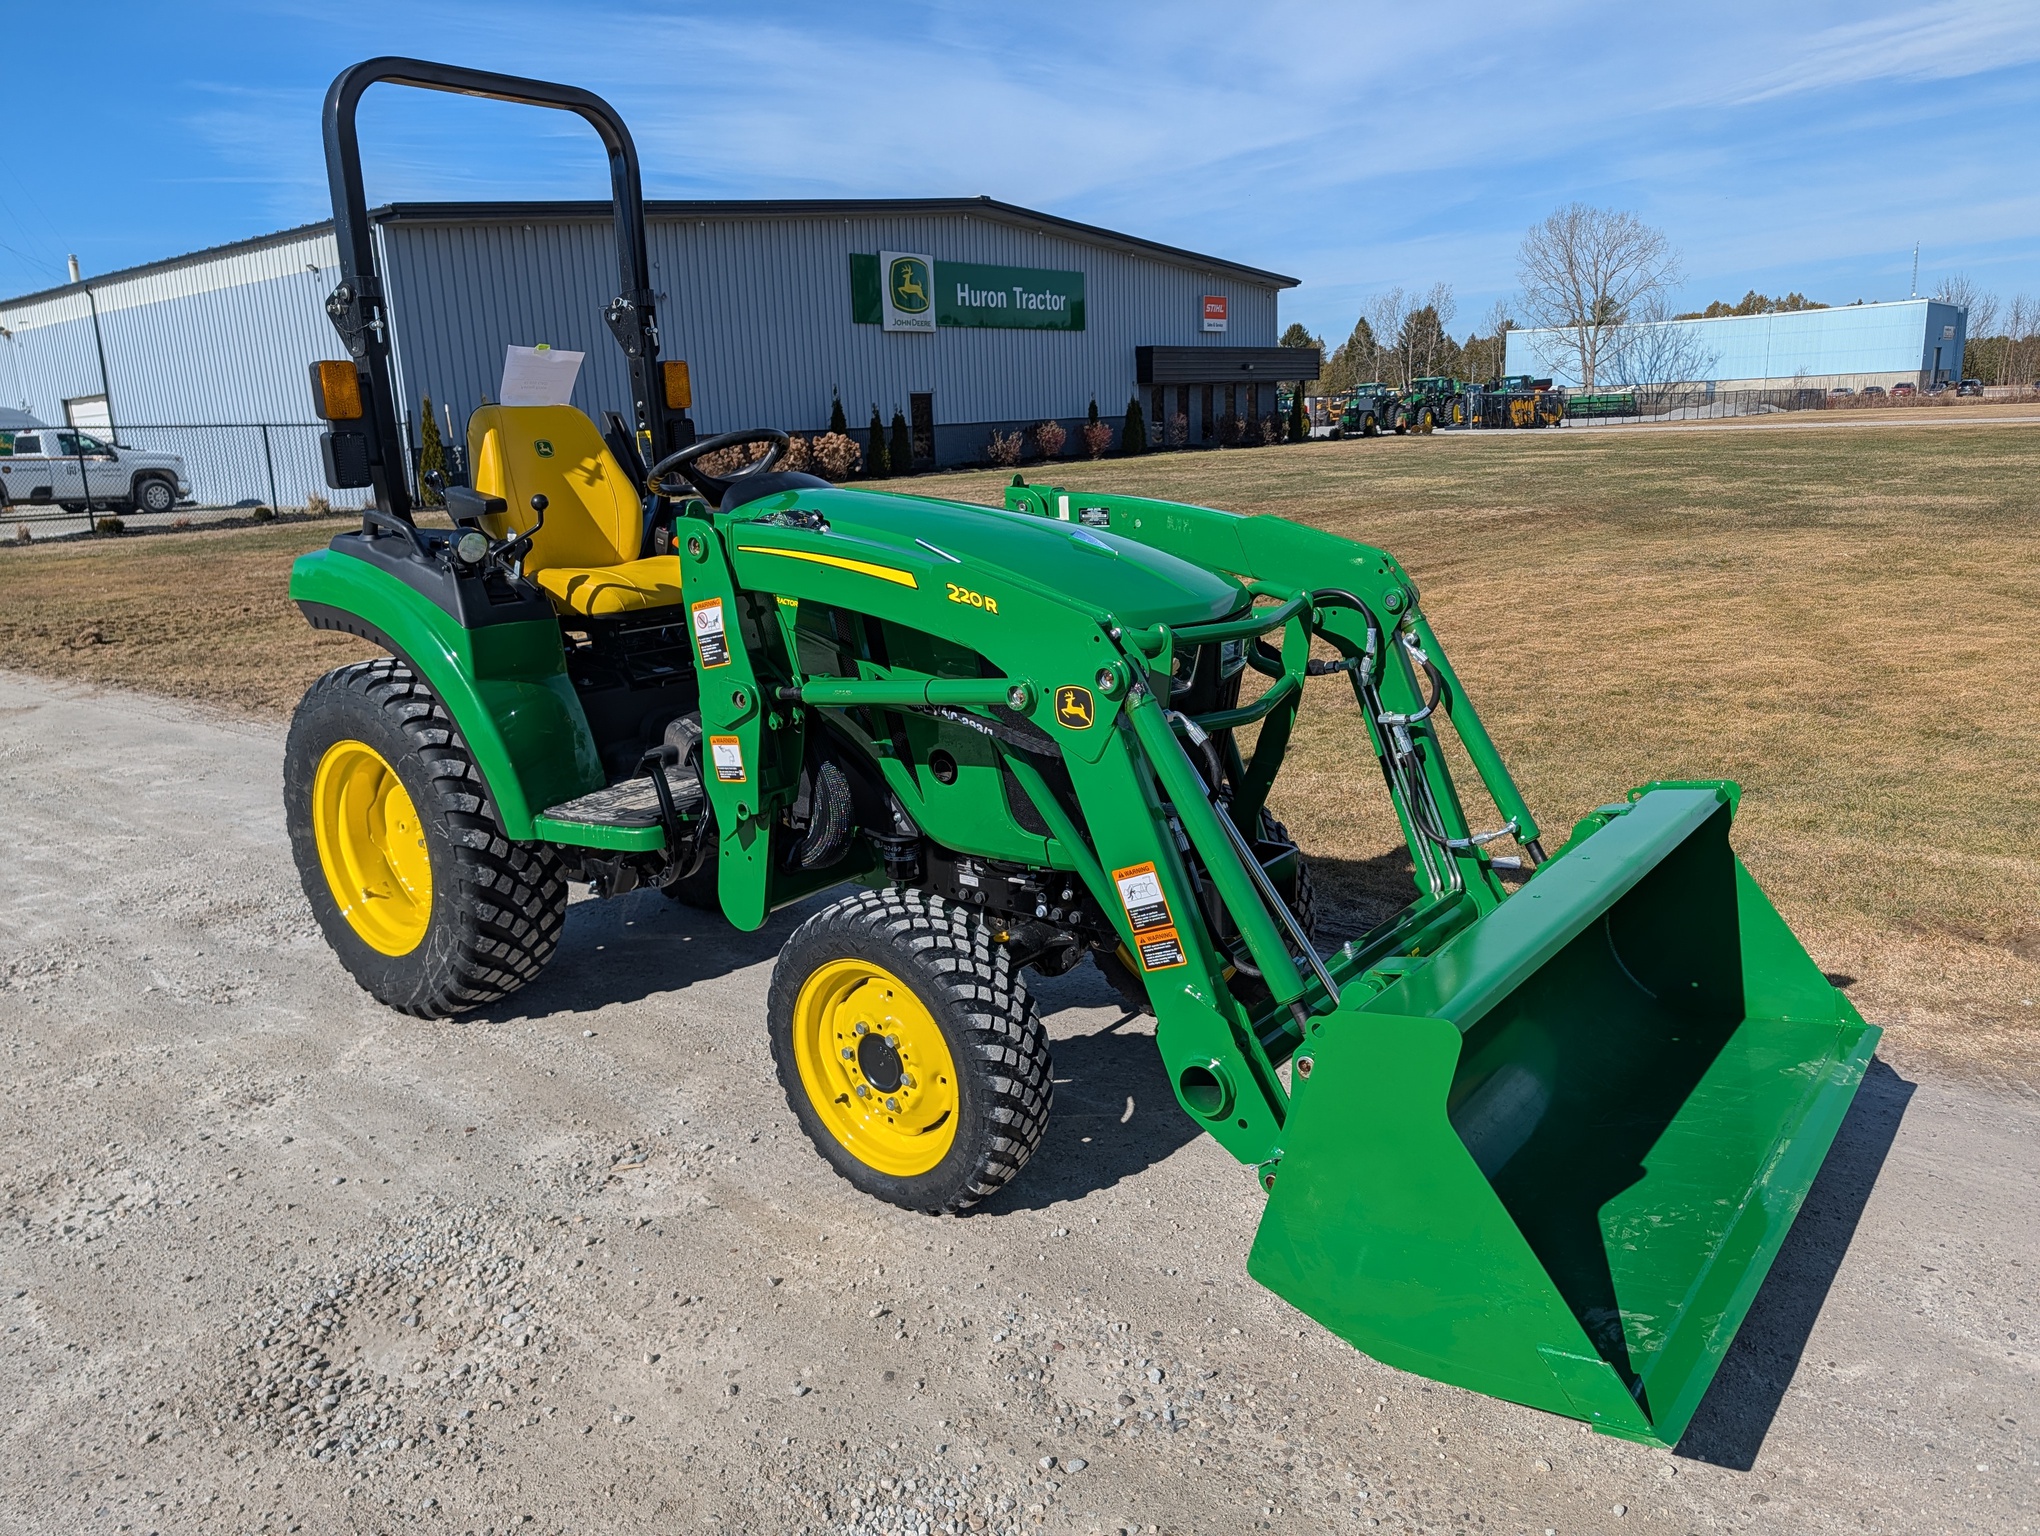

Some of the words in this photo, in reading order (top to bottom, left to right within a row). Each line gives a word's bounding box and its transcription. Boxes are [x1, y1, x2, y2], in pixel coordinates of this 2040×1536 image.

[957, 283, 1007, 308] Huron
[1012, 287, 1066, 311] Tractor
[1206, 303, 1225, 313] STIHL
[892, 318, 911, 326] JOHN
[912, 319, 931, 327] DEERE
[697, 599, 720, 610] WARNING
[1124, 866, 1150, 876] WARNING
[1147, 932, 1173, 941] WARNING
